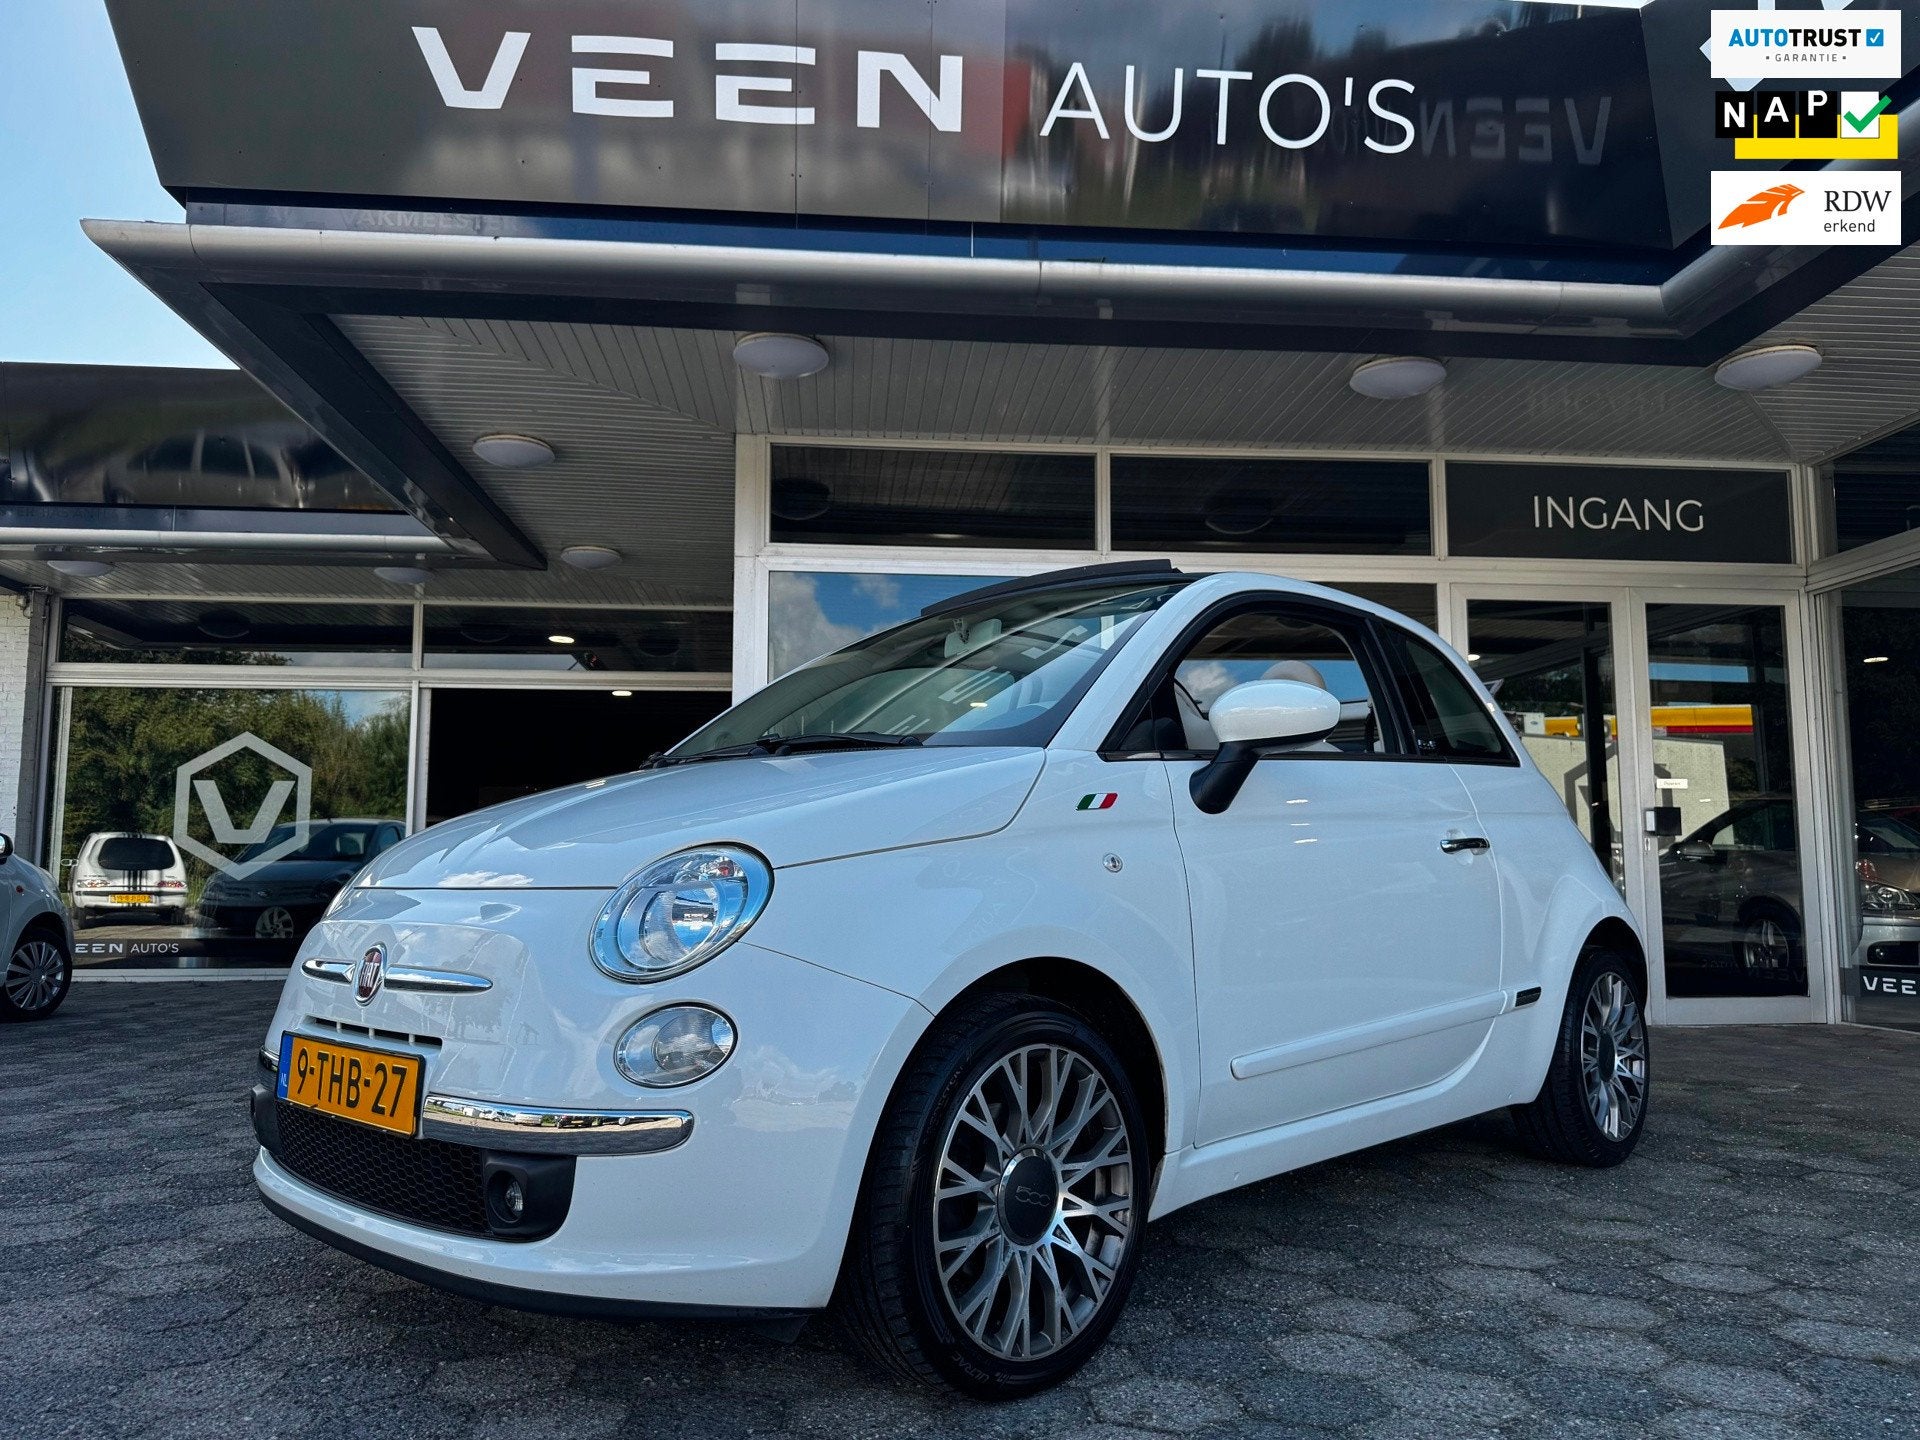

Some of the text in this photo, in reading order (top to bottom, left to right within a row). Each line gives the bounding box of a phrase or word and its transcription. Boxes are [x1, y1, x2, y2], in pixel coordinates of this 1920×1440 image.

[411, 26, 963, 132] VEEN
[1040, 62, 1416, 154] AUTO'S
[1533, 495, 1704, 532] INGANG
[75, 943, 179, 954] EEN AUTO'S
[297, 1047, 407, 1118] 9-THB-27
